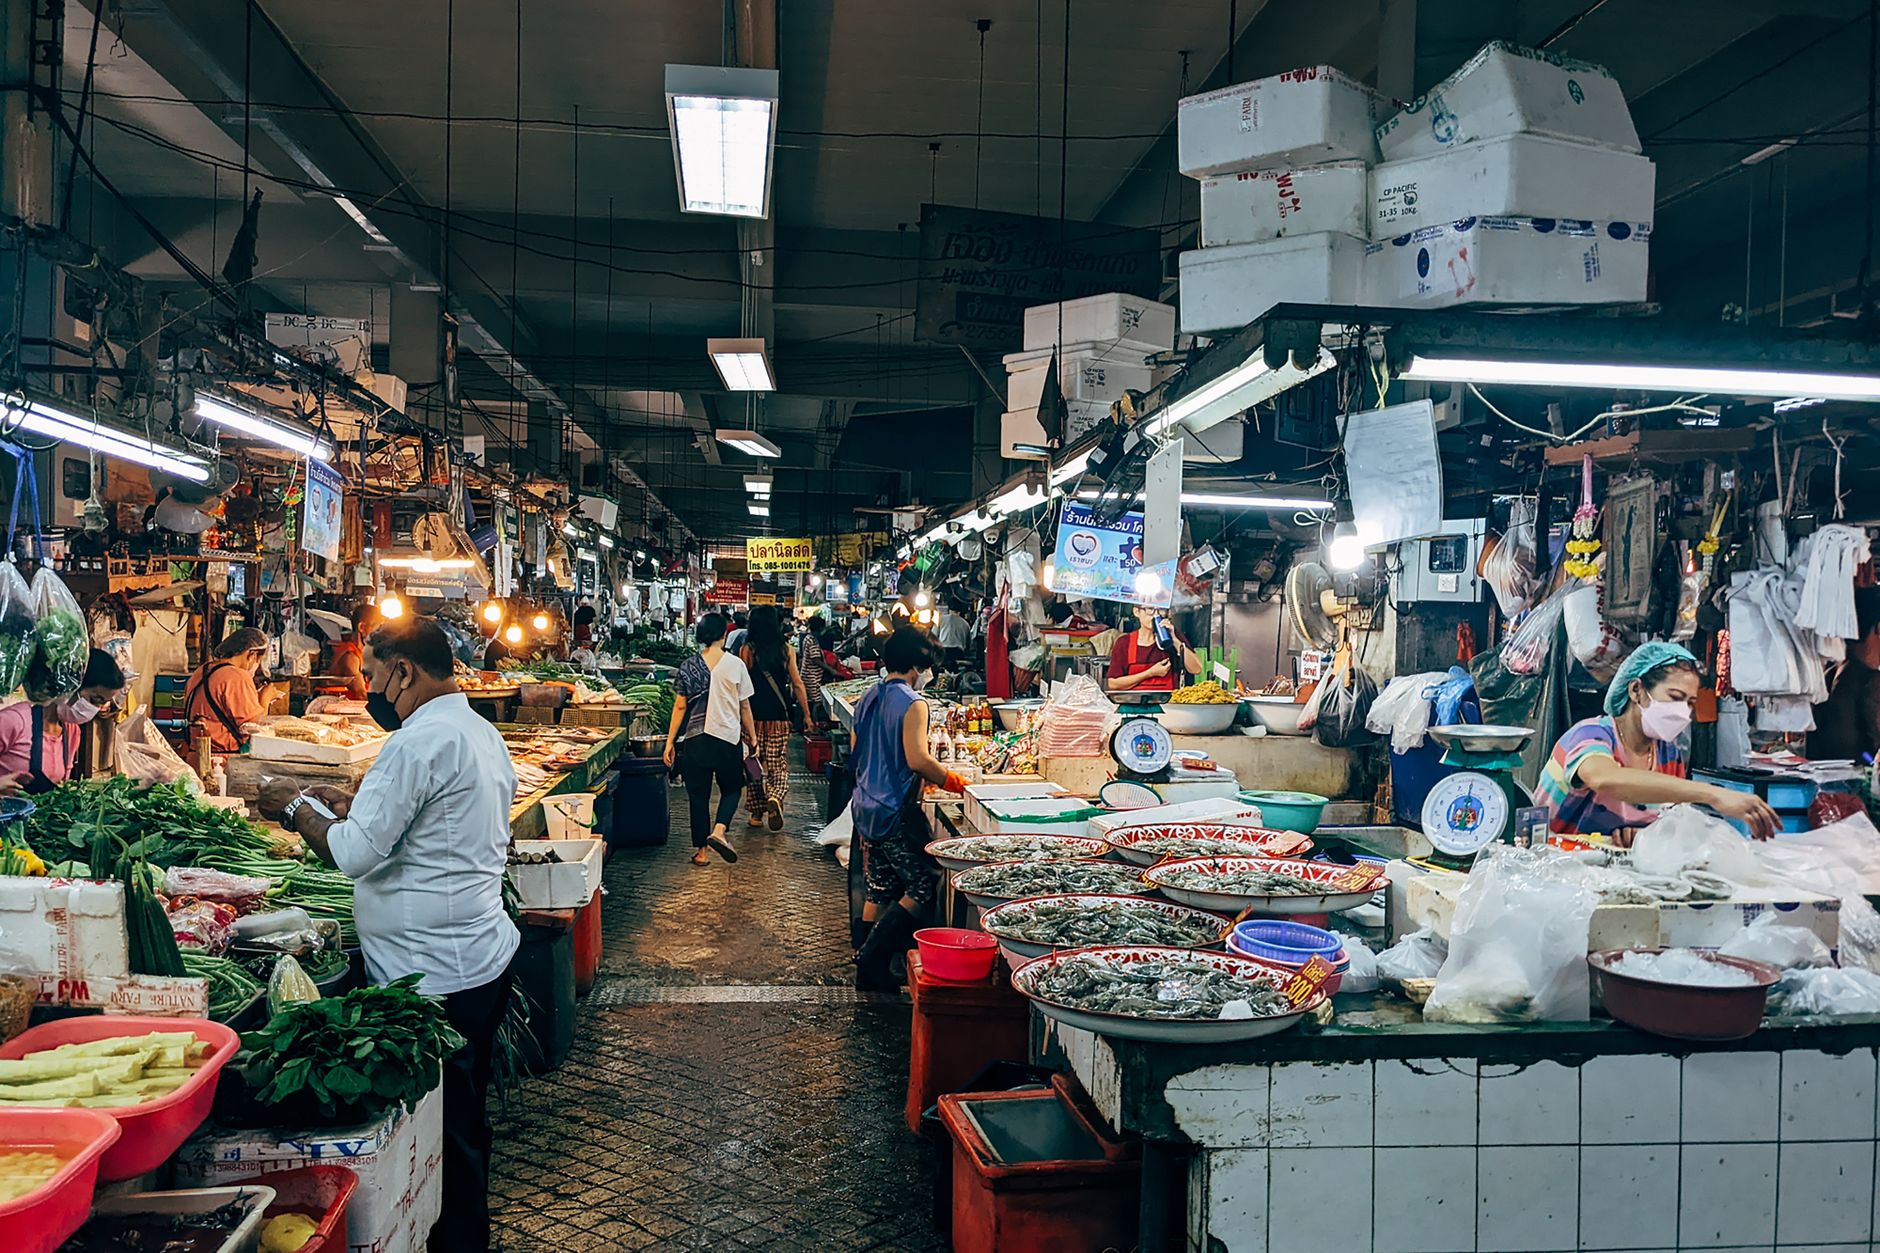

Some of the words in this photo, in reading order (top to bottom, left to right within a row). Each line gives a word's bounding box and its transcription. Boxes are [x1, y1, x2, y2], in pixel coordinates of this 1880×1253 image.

[750, 541, 810, 558] ปลานิลสด
[749, 559, 763, 570] โทร.
[1125, 558, 1136, 567] 50
[1333, 873, 1368, 890] 230
[111, 990, 142, 1006] FARM
[1284, 975, 1313, 1005] 300
[151, 992, 195, 1007] NATURE
